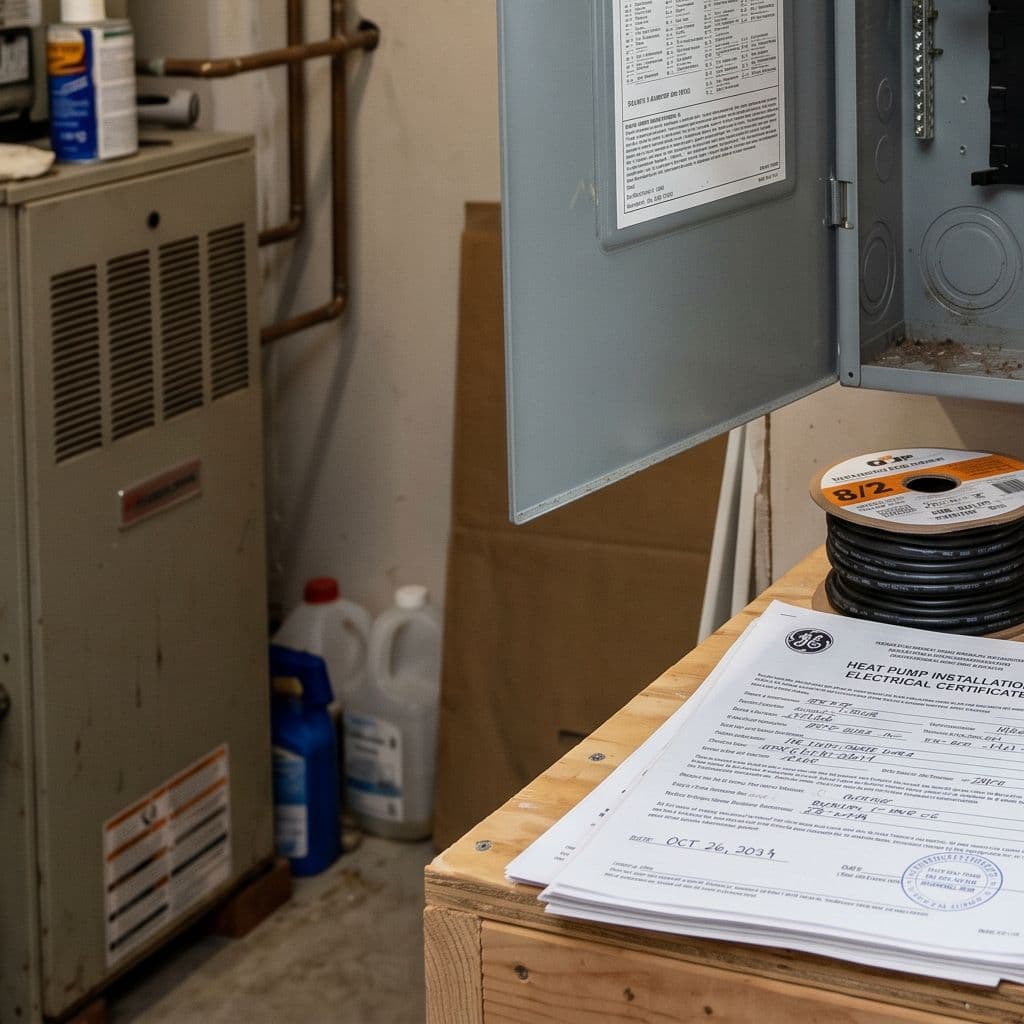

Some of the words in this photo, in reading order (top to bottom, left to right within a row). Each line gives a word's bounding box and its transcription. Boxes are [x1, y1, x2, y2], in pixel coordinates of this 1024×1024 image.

[832, 480, 894, 502] 8/2
[846, 660, 886, 673] HEAT
[887, 666, 929, 678] PUMP
[845, 670, 931, 688] ELECTRICAL
[666, 836, 701, 848] OCT
[704, 841, 729, 855] 26,
